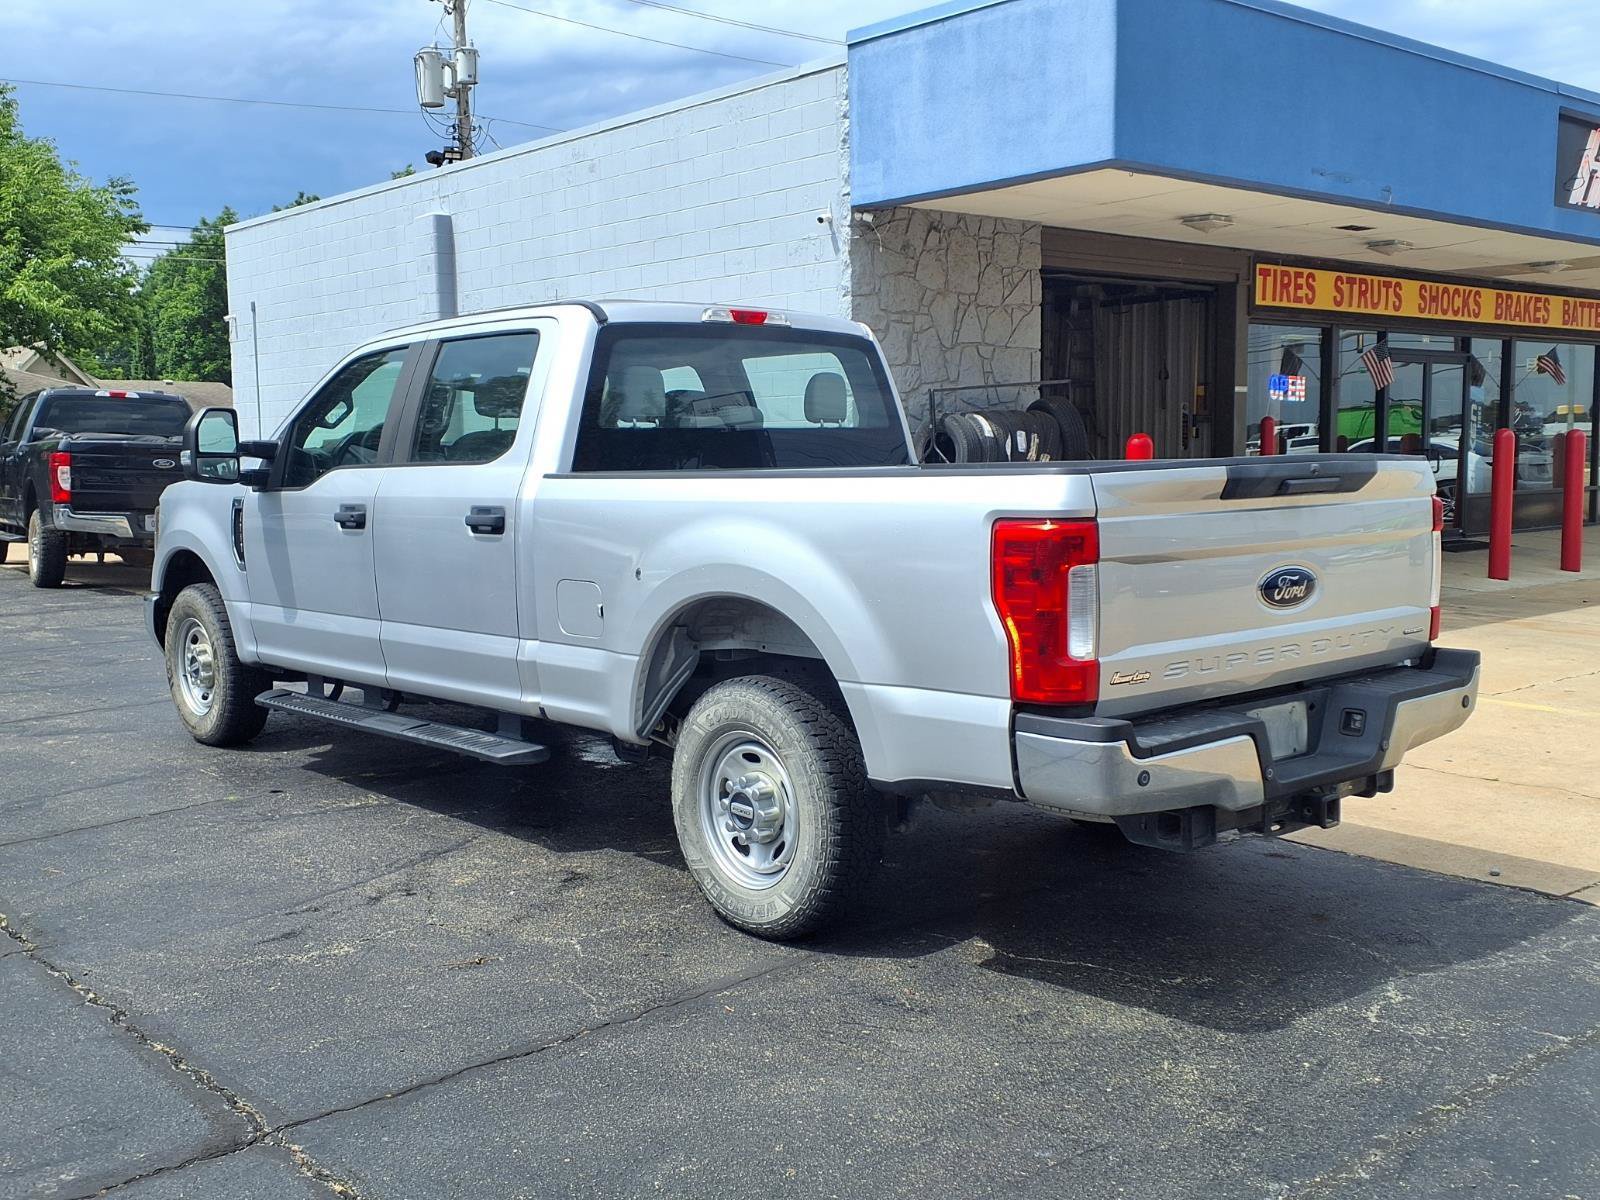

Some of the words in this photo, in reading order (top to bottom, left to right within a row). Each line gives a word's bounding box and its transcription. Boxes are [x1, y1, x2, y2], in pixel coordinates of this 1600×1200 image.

[1258, 267, 1316, 305] TIRES
[1333, 275, 1403, 312] STRUTS
[1418, 283, 1482, 319] SHOCKS
[1494, 292, 1551, 325] BRAKES
[1268, 374, 1306, 402] OPEN
[1274, 575, 1308, 601] Ford
[1163, 642, 1301, 681] SUPER
[1311, 626, 1395, 656] DUTY
